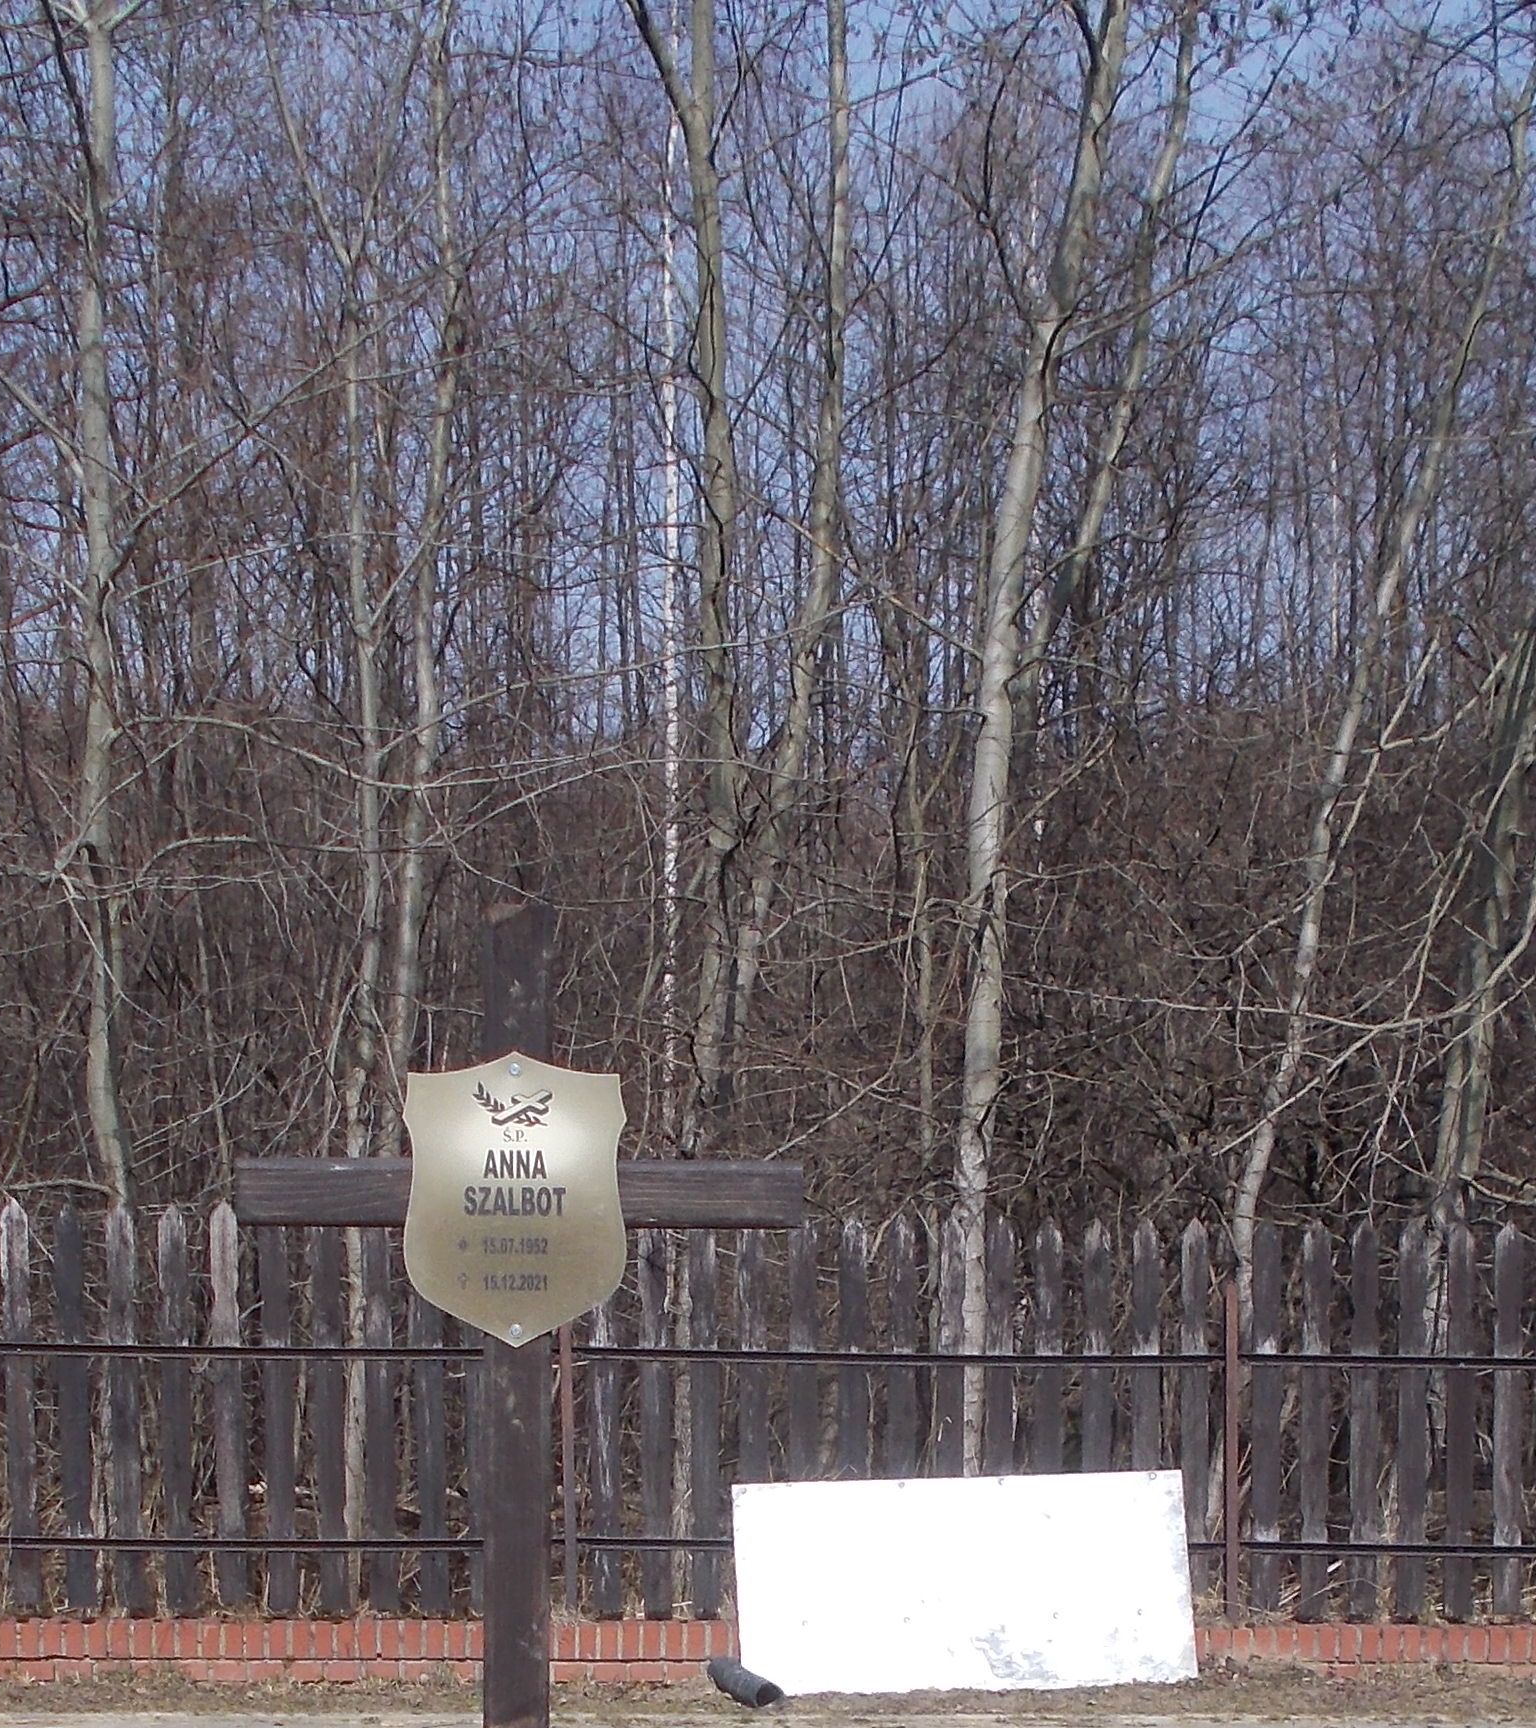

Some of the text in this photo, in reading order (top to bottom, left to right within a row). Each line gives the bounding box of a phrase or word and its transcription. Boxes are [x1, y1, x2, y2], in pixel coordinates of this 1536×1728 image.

[483, 1149, 548, 1180] ANNA
[463, 1186, 566, 1217] SZALBOT
[482, 1274, 549, 1292] 15.12.2021
